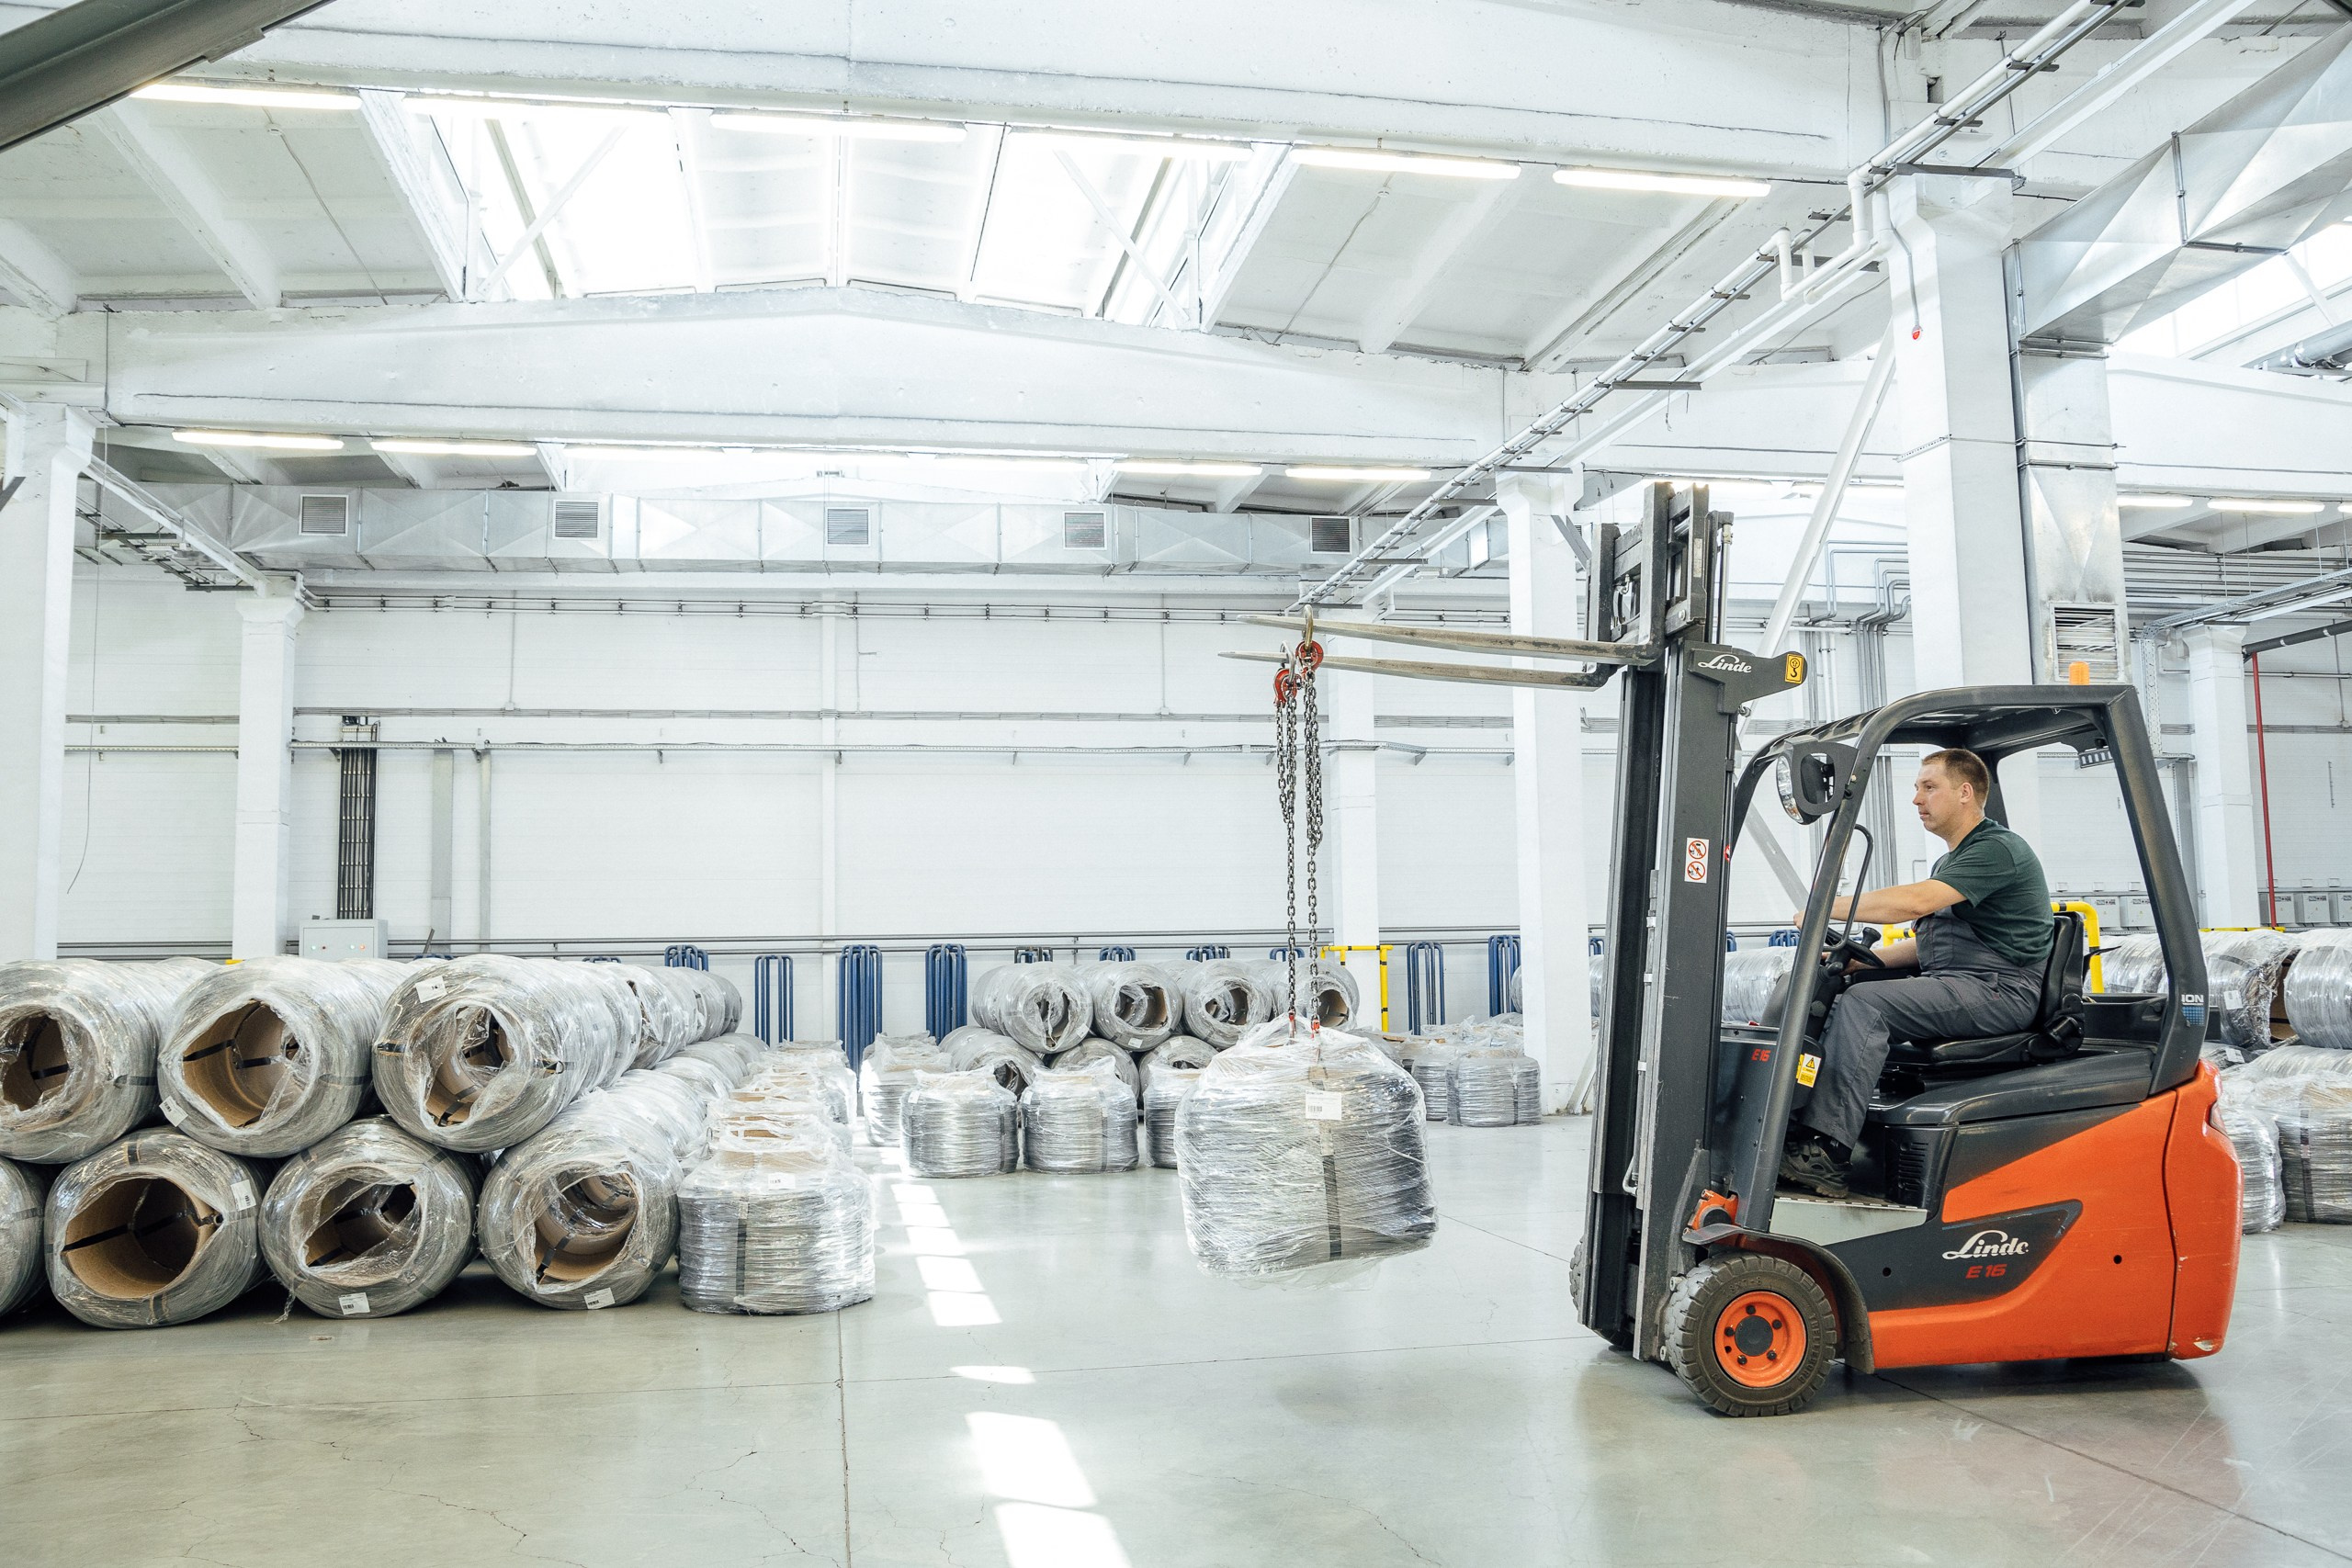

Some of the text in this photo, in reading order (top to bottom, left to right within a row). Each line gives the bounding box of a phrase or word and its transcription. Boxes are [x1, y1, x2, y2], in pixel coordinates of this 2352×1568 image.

[1698, 654, 1752, 673] Linde
[2181, 994, 2204, 1003] ION
[1941, 1229, 2030, 1260] Linde
